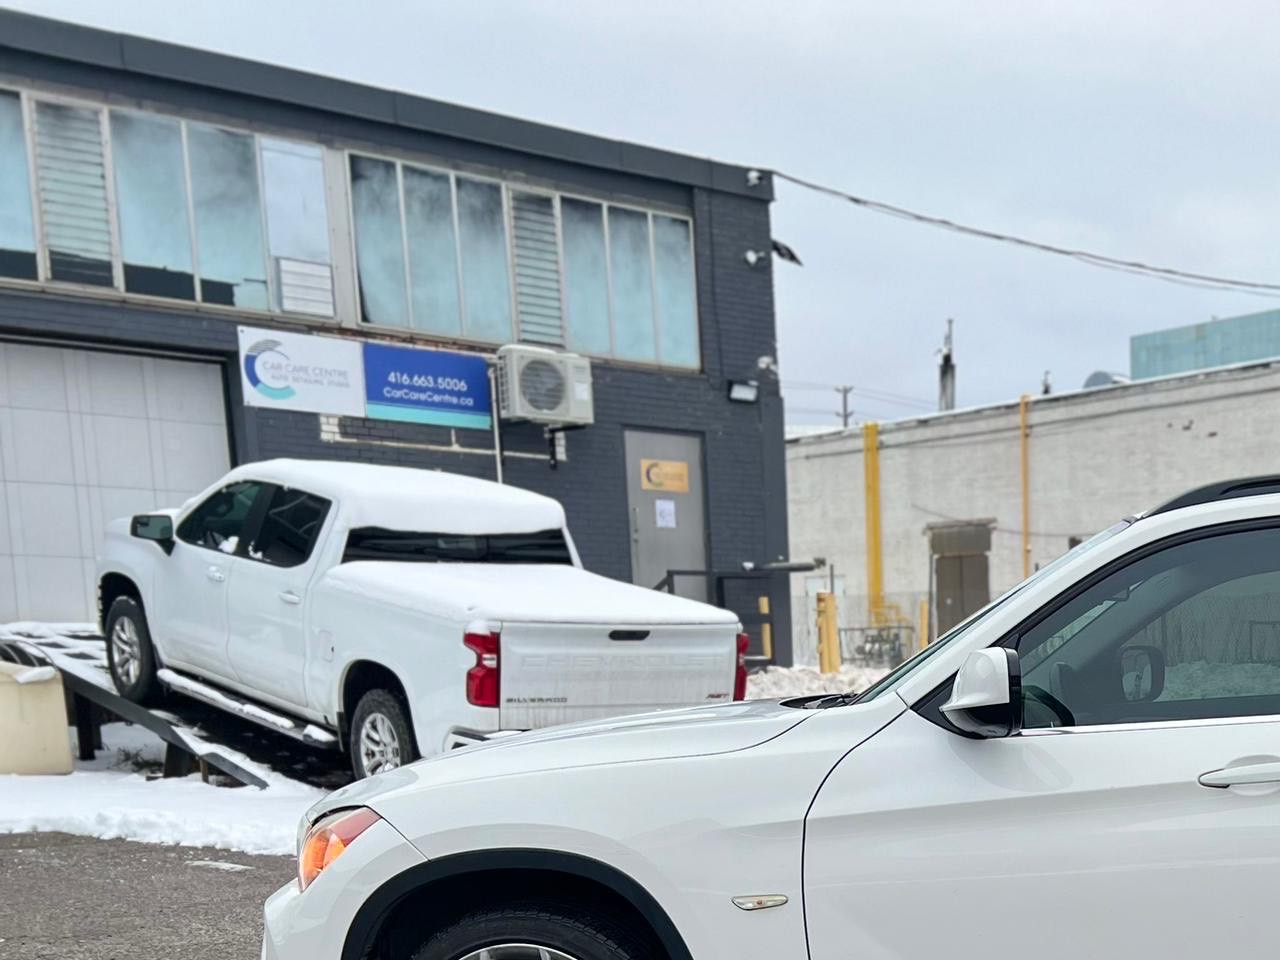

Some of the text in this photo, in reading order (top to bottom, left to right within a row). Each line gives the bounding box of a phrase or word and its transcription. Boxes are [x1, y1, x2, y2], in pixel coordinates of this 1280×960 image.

[262, 361, 348, 378] CAR CARE CENTRE
[387, 371, 468, 392] 416.663.5006
[383, 386, 474, 406] CarCareCentre.ca
